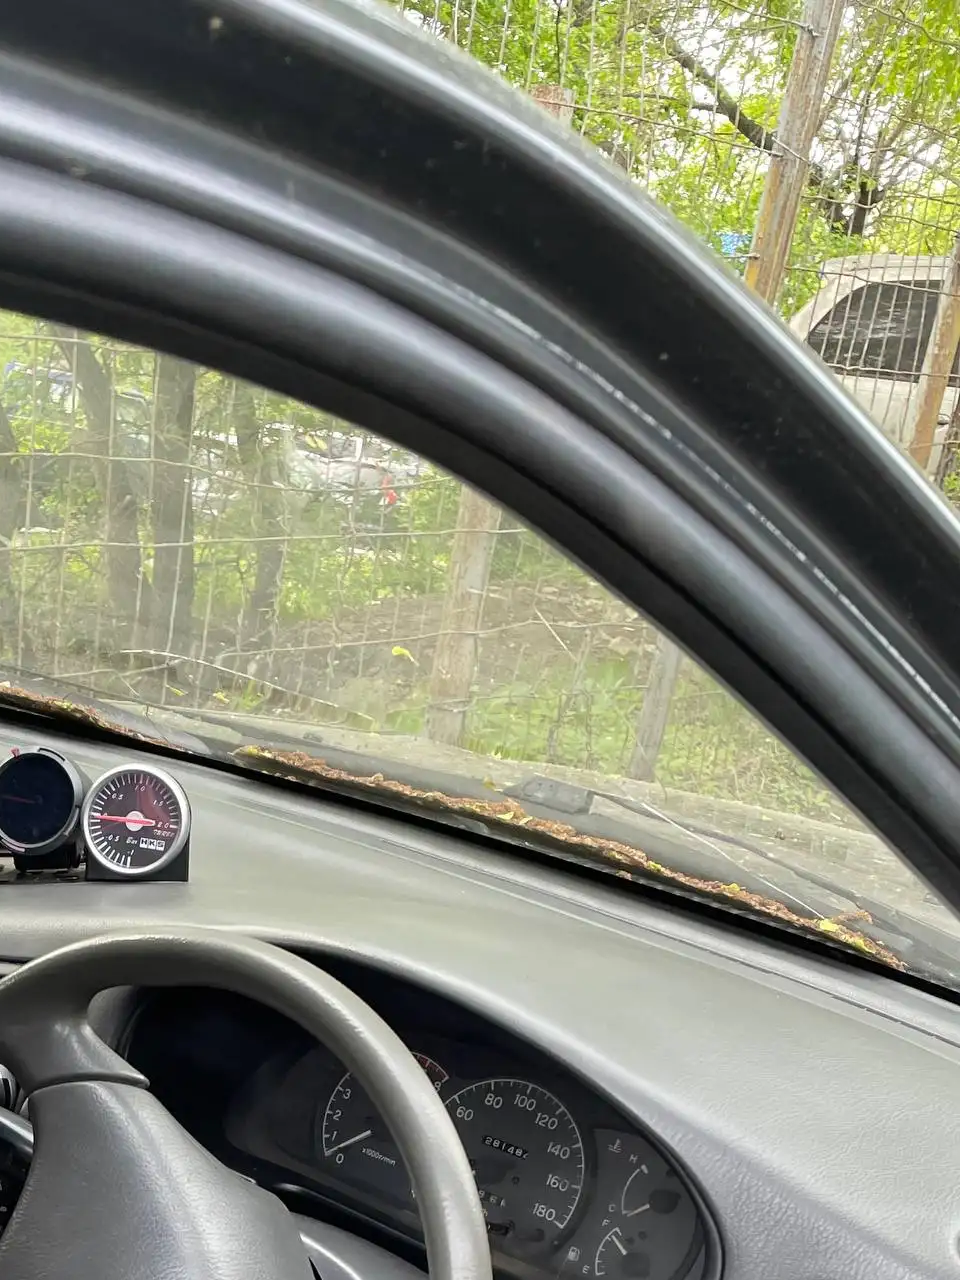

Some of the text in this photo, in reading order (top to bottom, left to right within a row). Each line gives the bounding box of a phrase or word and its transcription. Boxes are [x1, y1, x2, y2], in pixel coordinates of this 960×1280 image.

[140, 837, 165, 851] HKS
[343, 1088, 351, 1099] 3
[484, 1093, 503, 1109] 80
[513, 1094, 536, 1111] 100
[333, 1109, 342, 1120] 2
[456, 1106, 474, 1121] 60
[535, 1112, 558, 1130] 120
[547, 1141, 570, 1159] 140
[335, 1153, 344, 1164] 0
[629, 1154, 638, 1164] H
[546, 1174, 569, 1192] 160
[532, 1202, 556, 1221] 180
[608, 1203, 616, 1213] C
[601, 1219, 610, 1227] F
[582, 1264, 590, 1274] E
